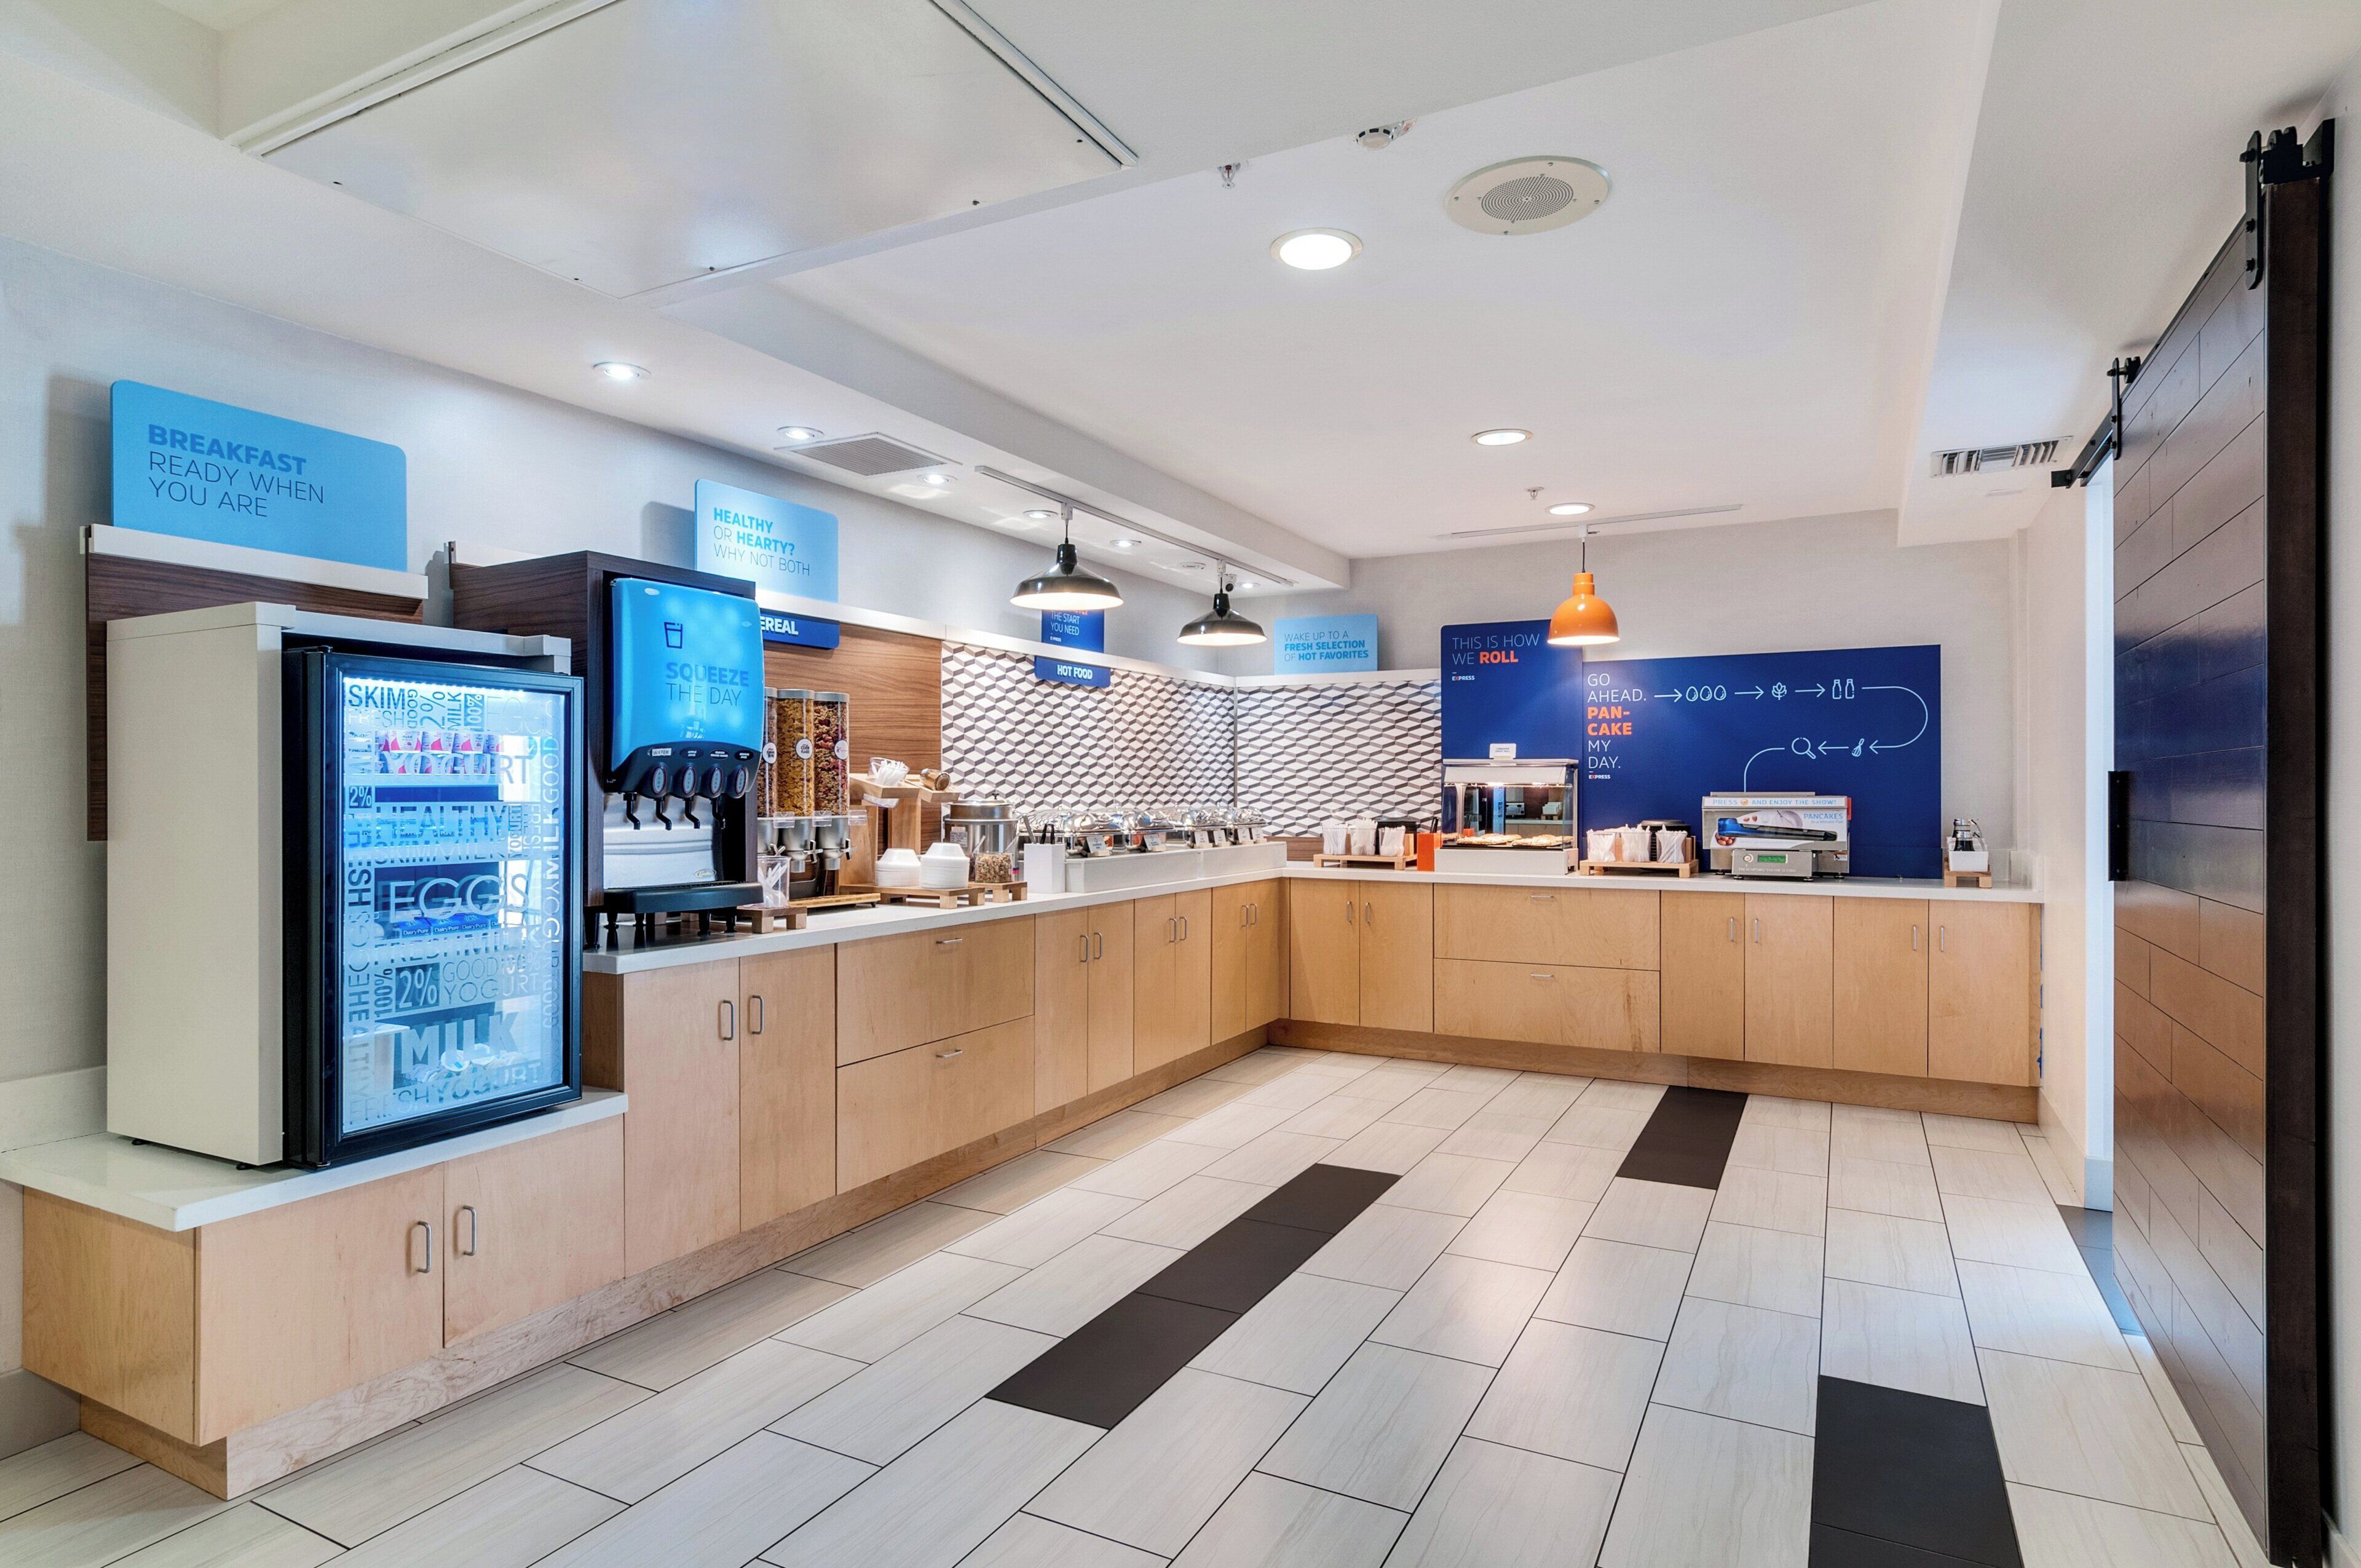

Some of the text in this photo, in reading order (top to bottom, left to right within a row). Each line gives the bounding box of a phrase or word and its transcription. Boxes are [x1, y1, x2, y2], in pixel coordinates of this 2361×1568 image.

[148, 424, 306, 475] BREAKFAST
[149, 451, 324, 504] READY WHEN
[149, 477, 267, 517] YOU ARE
[713, 507, 773, 534] HEALTHY
[713, 525, 795, 556] OR HEARTY?
[714, 542, 810, 576] WHY NOT BOTH
[761, 616, 799, 636] EREAL
[1050, 622, 1080, 636] YOU NEED
[1051, 611, 1062, 622] THE
[1063, 613, 1080, 625] START
[1284, 630, 1349, 642] WAKE UP TO A
[1284, 640, 1366, 652] FRESH SELECTION
[1452, 633, 1540, 650] THIS IS HOW
[1284, 650, 1369, 662] OF HOT FAVORITES
[1452, 651, 1519, 665] WE ROLL
[665, 661, 749, 688] SQUEEZE
[1057, 664, 1093, 680] HOT FOOD
[1587, 673, 1610, 687] GO
[349, 684, 405, 710] SKIM
[665, 683, 743, 707] THE DAY
[1587, 689, 1647, 703] AHEAD.
[407, 689, 418, 729] GOOD
[420, 691, 446, 730] 2%
[1588, 706, 1631, 719] PAN-
[1588, 722, 1632, 736] CAKE
[1588, 740, 1612, 753] MY
[1588, 756, 1621, 769] DAY.
[350, 786, 372, 807] 2%
[376, 806, 507, 839] HEALTHY
[390, 873, 530, 922] EGGS
[442, 957, 498, 983] GOOD
[374, 968, 394, 1018] 100%
[400, 967, 438, 1009] 2%
[443, 973, 540, 1005] YOGURT
[401, 1011, 520, 1075] MILK
